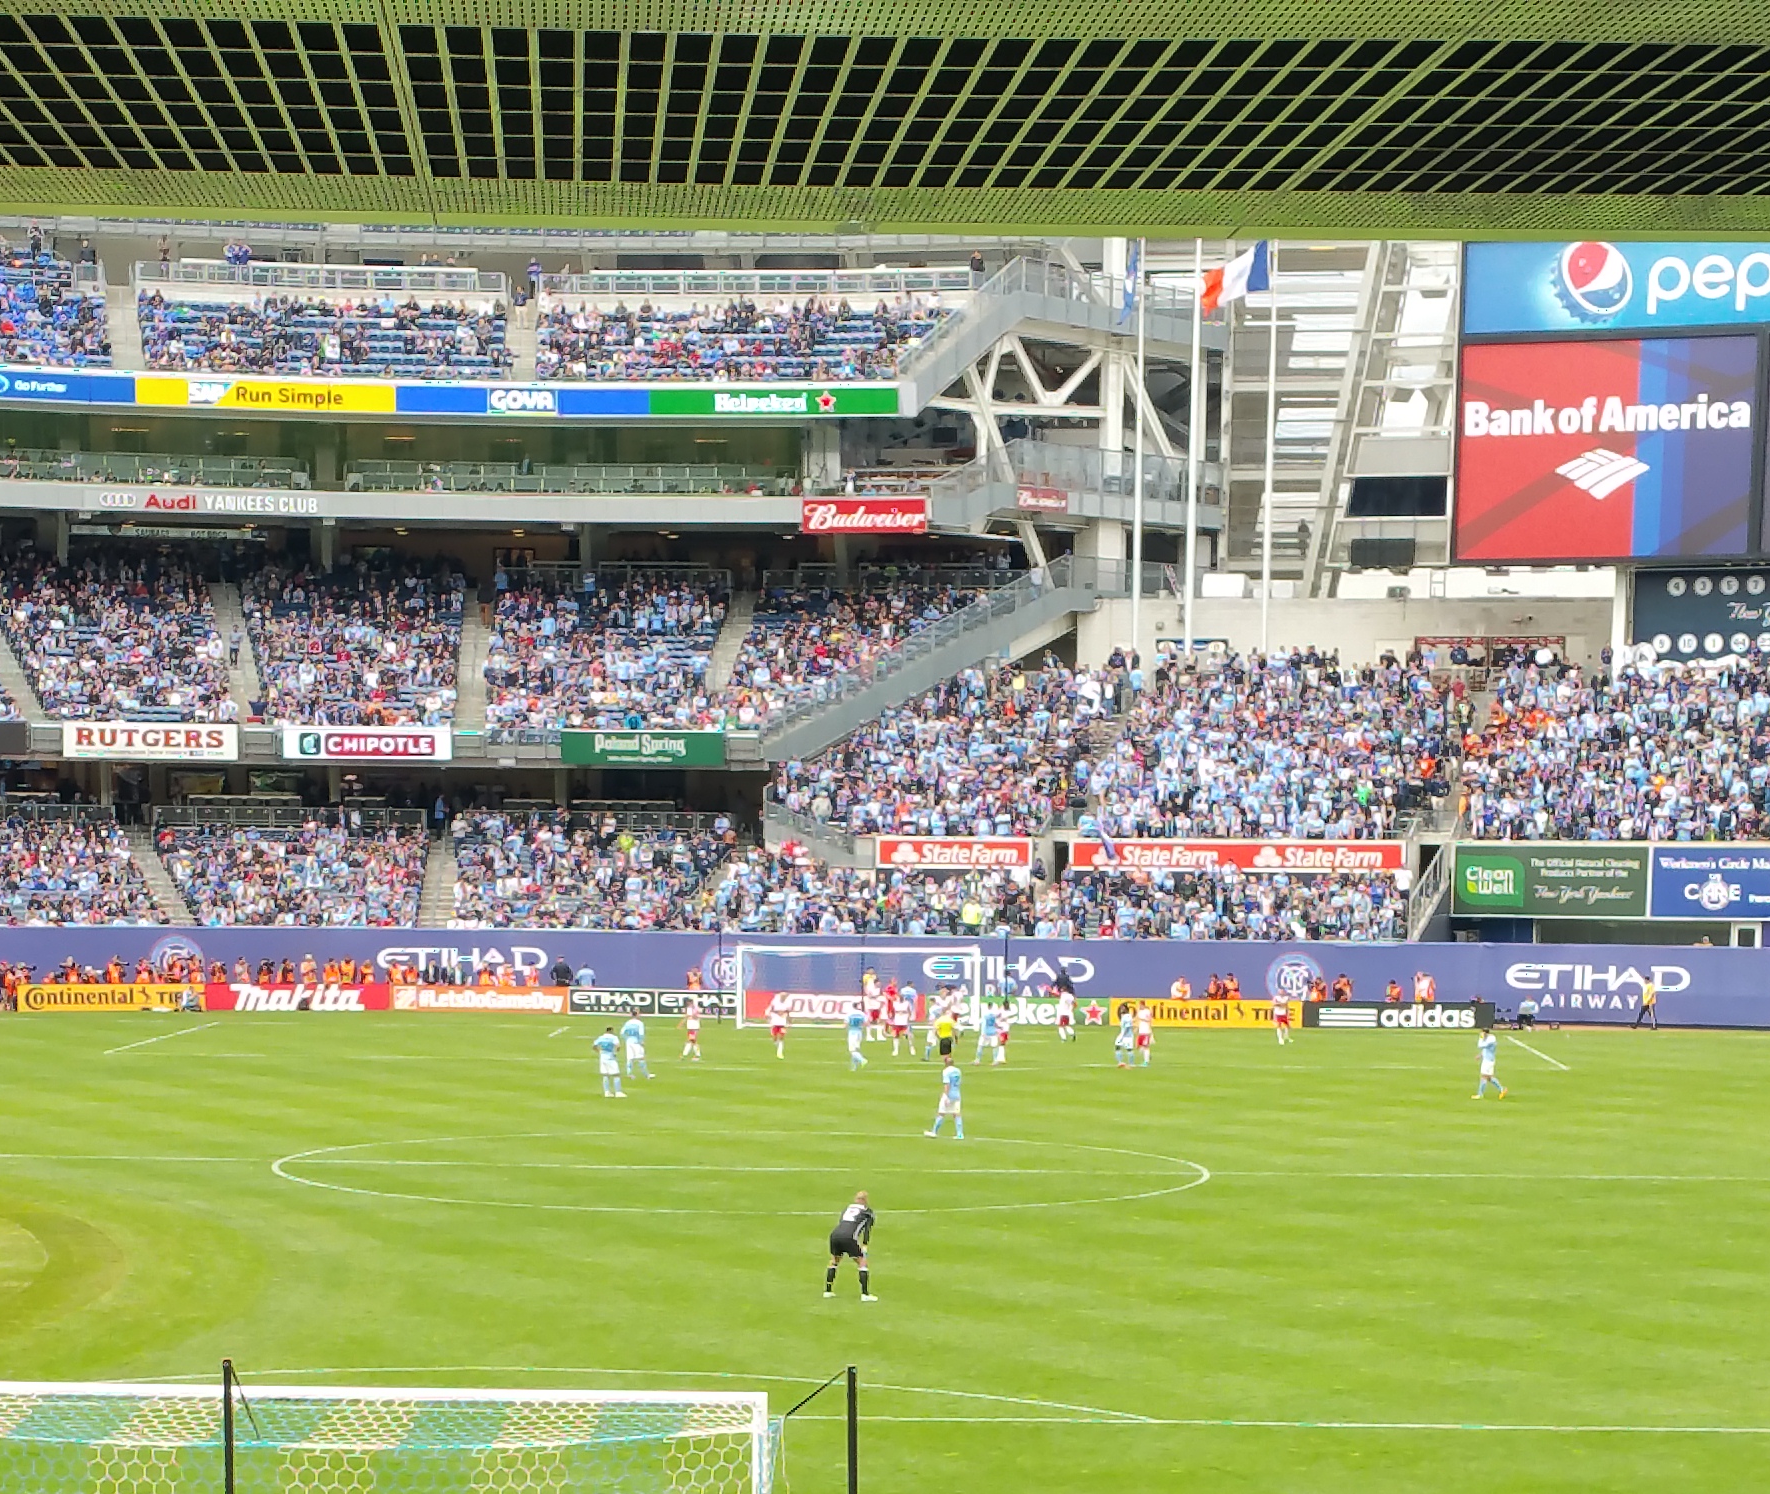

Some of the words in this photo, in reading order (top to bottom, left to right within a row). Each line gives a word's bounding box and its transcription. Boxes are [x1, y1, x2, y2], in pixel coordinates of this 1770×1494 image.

[236, 387, 271, 404] Run
[277, 389, 344, 407] Simple
[1465, 400, 1554, 437] Bank
[1559, 398, 1597, 433] of
[1599, 394, 1751, 433] America
[144, 494, 197, 510] Audi
[205, 495, 274, 512] YANKEES
[279, 497, 318, 513] CLUB
[805, 503, 925, 530] Budweiser
[75, 728, 225, 748] RUTGERS
[327, 735, 434, 754] CHIPOTLE
[641, 733, 687, 757] Spring
[1465, 866, 1514, 881] Clean
[376, 947, 548, 972] ETIHAD
[922, 956, 1095, 982] ETIHAD
[1505, 963, 1691, 992] ETIHAD
[25, 986, 135, 1010] Continental
[419, 989, 565, 1013] #LetsDoGameDay
[572, 991, 652, 1006] ETIHAD
[1540, 994, 1641, 1009] AIRWAY
[1380, 1004, 1476, 1028] adidas
